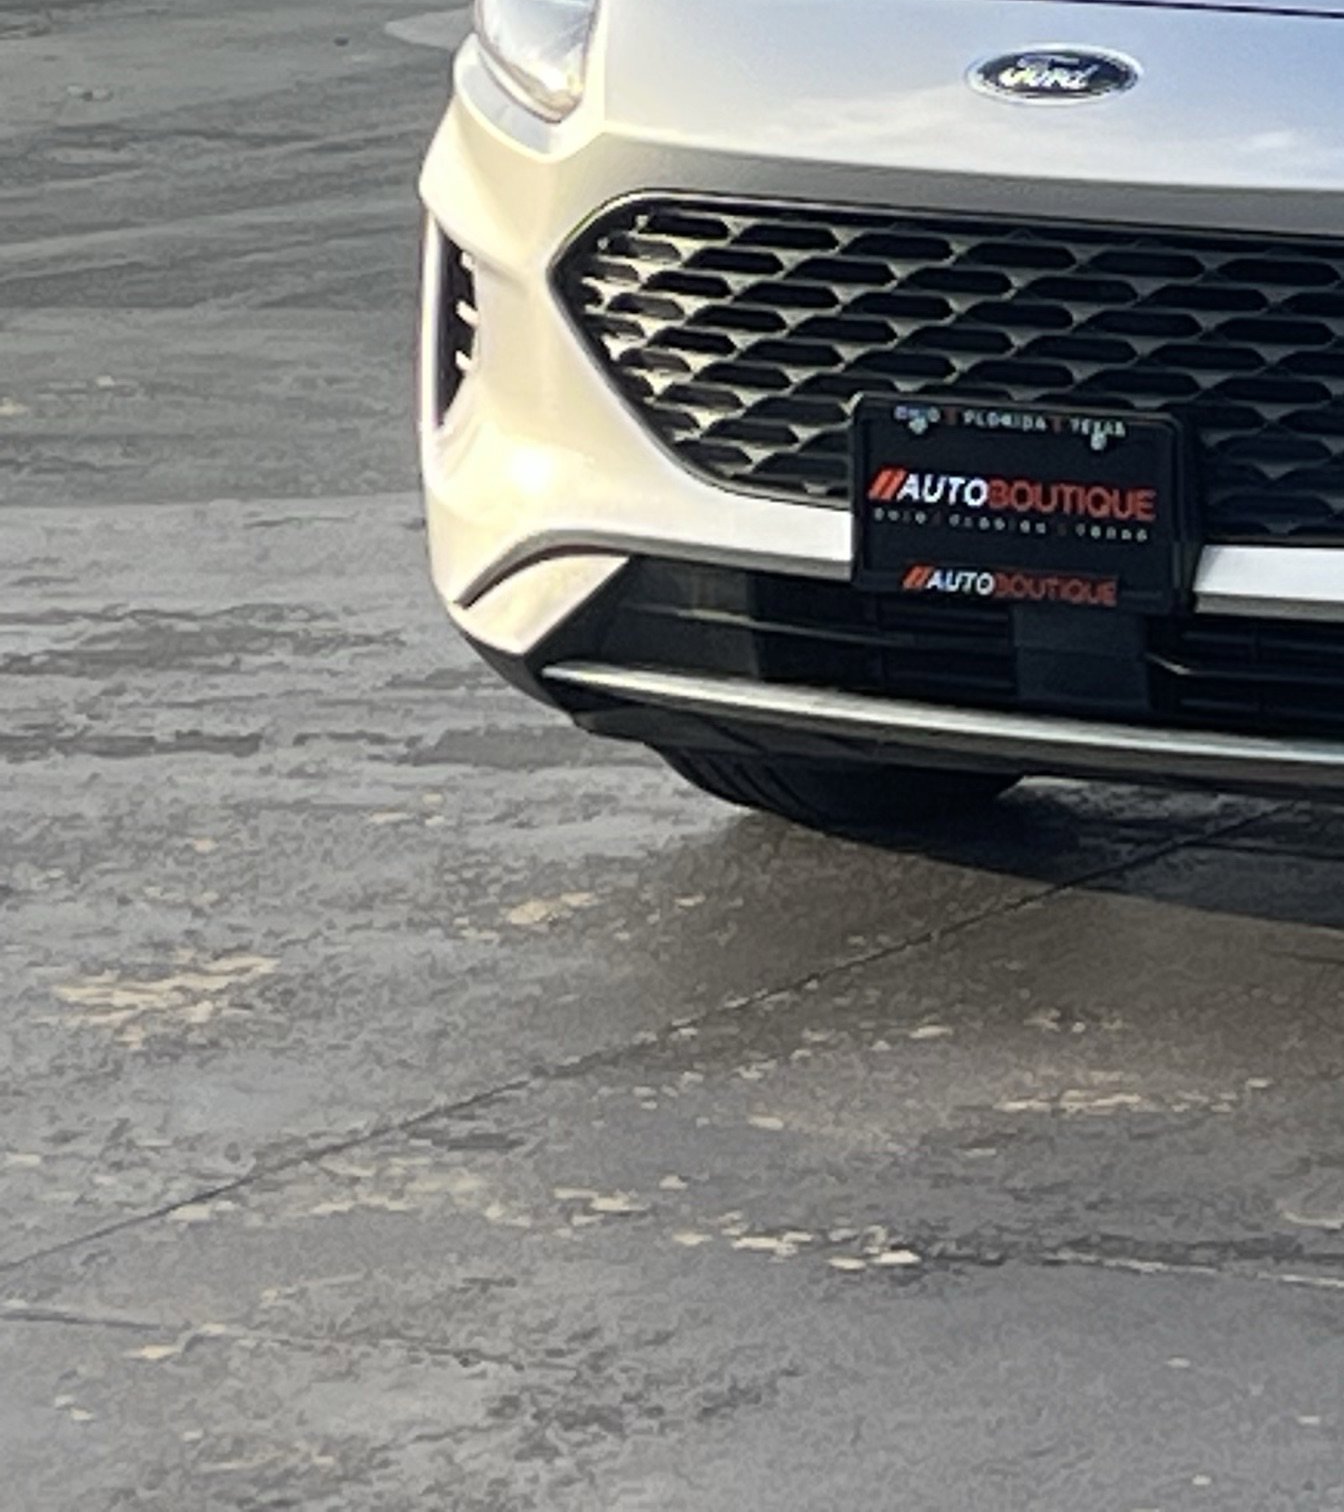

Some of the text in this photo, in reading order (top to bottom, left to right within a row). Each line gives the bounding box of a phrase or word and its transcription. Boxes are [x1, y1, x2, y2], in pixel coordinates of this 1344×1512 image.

[962, 410, 1047, 431] FLORIDA
[897, 472, 1157, 521] AUTOBOUTIQUE
[927, 570, 1117, 607] AUTOBOUTIQUE
